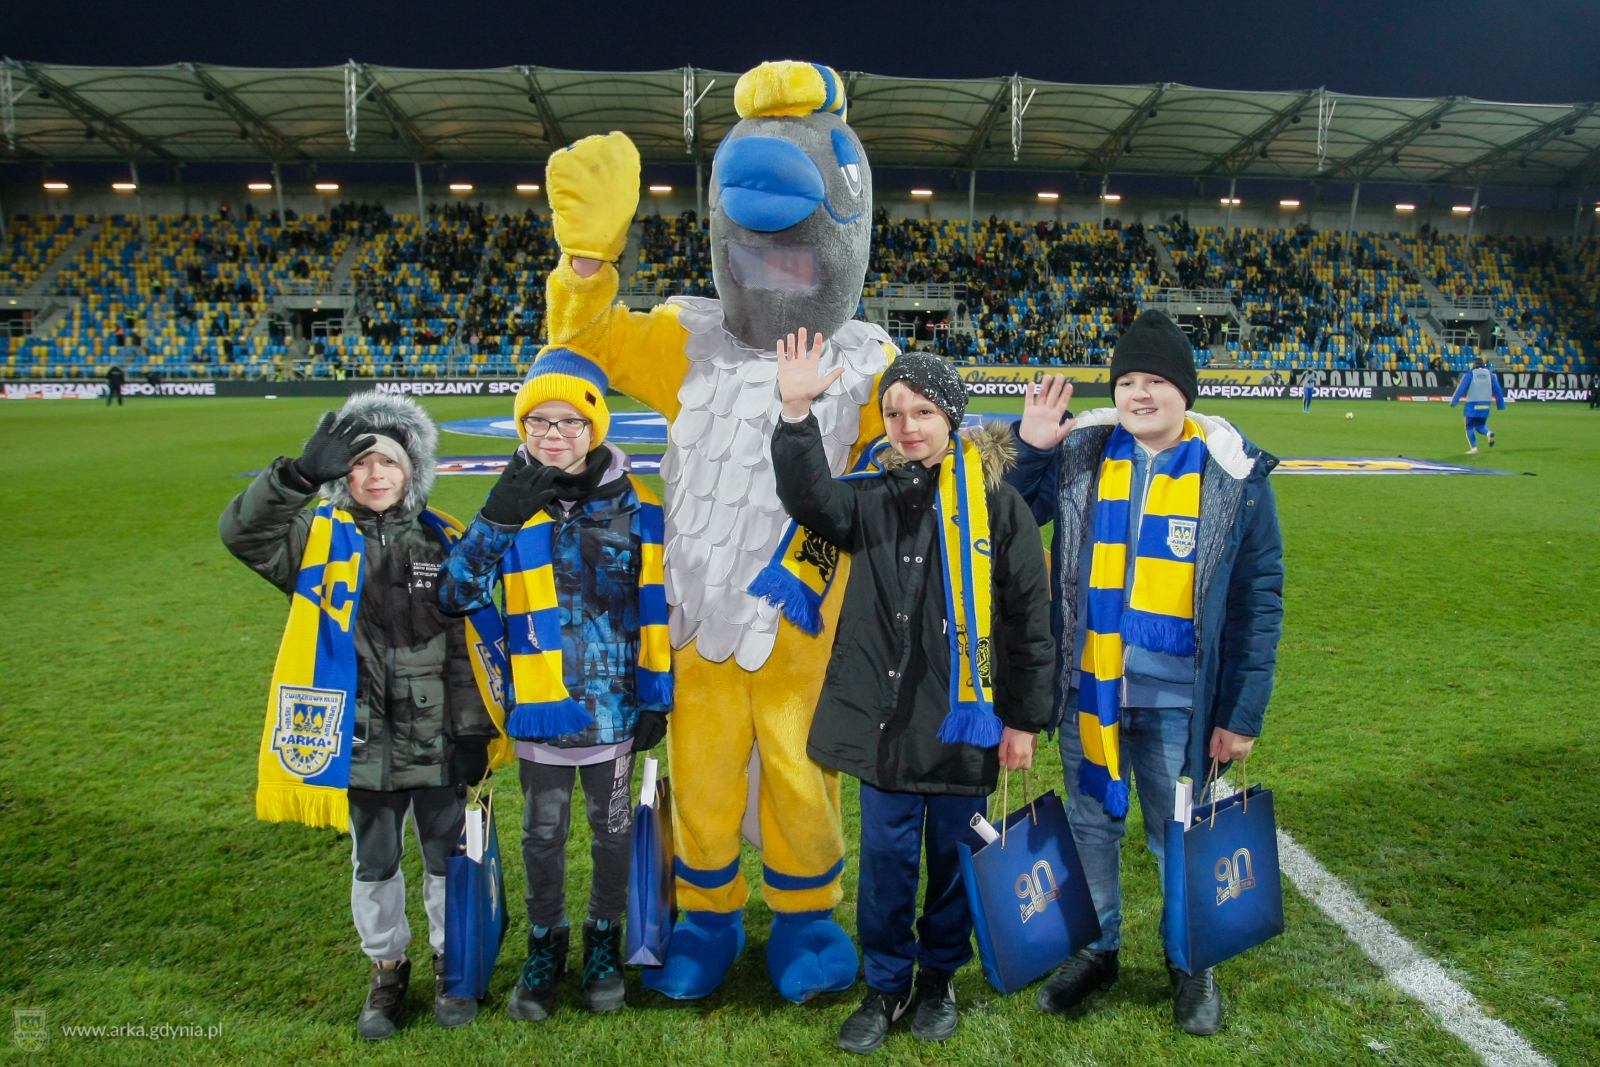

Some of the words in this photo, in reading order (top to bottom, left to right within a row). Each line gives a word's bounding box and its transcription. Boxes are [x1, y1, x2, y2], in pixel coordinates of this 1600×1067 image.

[376, 382, 484, 396] NAPĘDZAMY
[1507, 389, 1592, 402] NAPĘDZAM
[287, 735, 326, 747] ARKA
